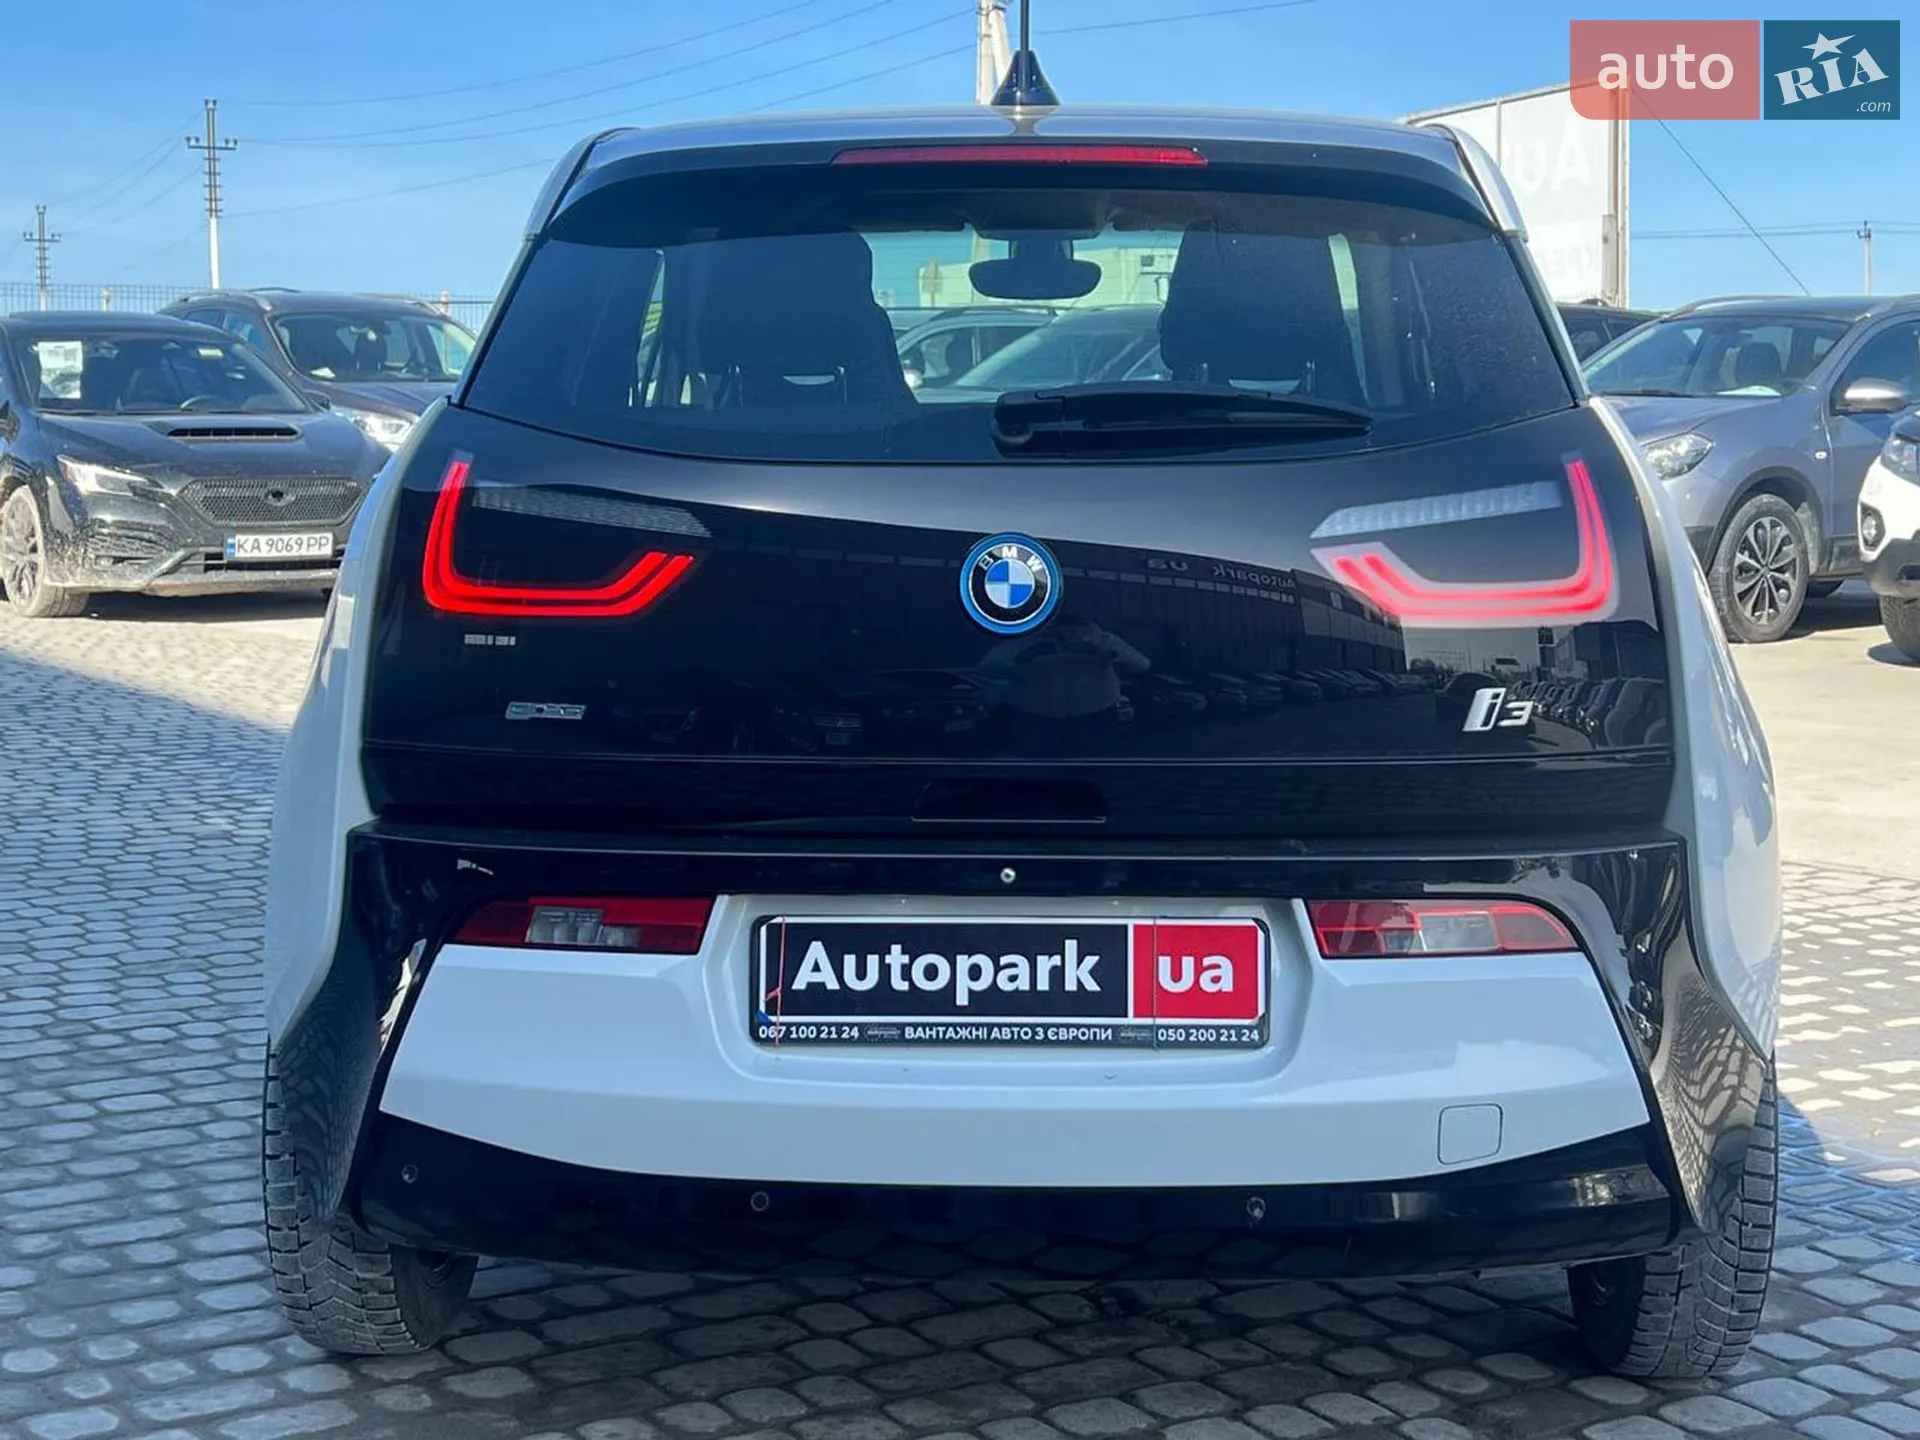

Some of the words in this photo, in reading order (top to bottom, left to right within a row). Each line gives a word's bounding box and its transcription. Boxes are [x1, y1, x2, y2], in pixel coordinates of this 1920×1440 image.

[237, 538, 261, 553] KA
[265, 537, 303, 553] 9069
[307, 535, 329, 551] PP
[978, 546, 1043, 571] BMW
[1462, 687, 1533, 732] i3
[791, 939, 1101, 1006] Autopark
[1157, 953, 1233, 993] ua
[758, 1025, 786, 1039] 067
[789, 1026, 817, 1039] 100
[819, 1026, 838, 1039] 21
[840, 1026, 860, 1039] 24
[904, 1026, 987, 1040] ВАНТАЖНІ
[989, 1027, 1032, 1040] АВТО
[1047, 1027, 1113, 1041] ЄВРОПИ
[1157, 1028, 1185, 1042] 050
[1188, 1028, 1216, 1042] 200
[1219, 1028, 1238, 1042] 21
[1240, 1028, 1260, 1042] 24
